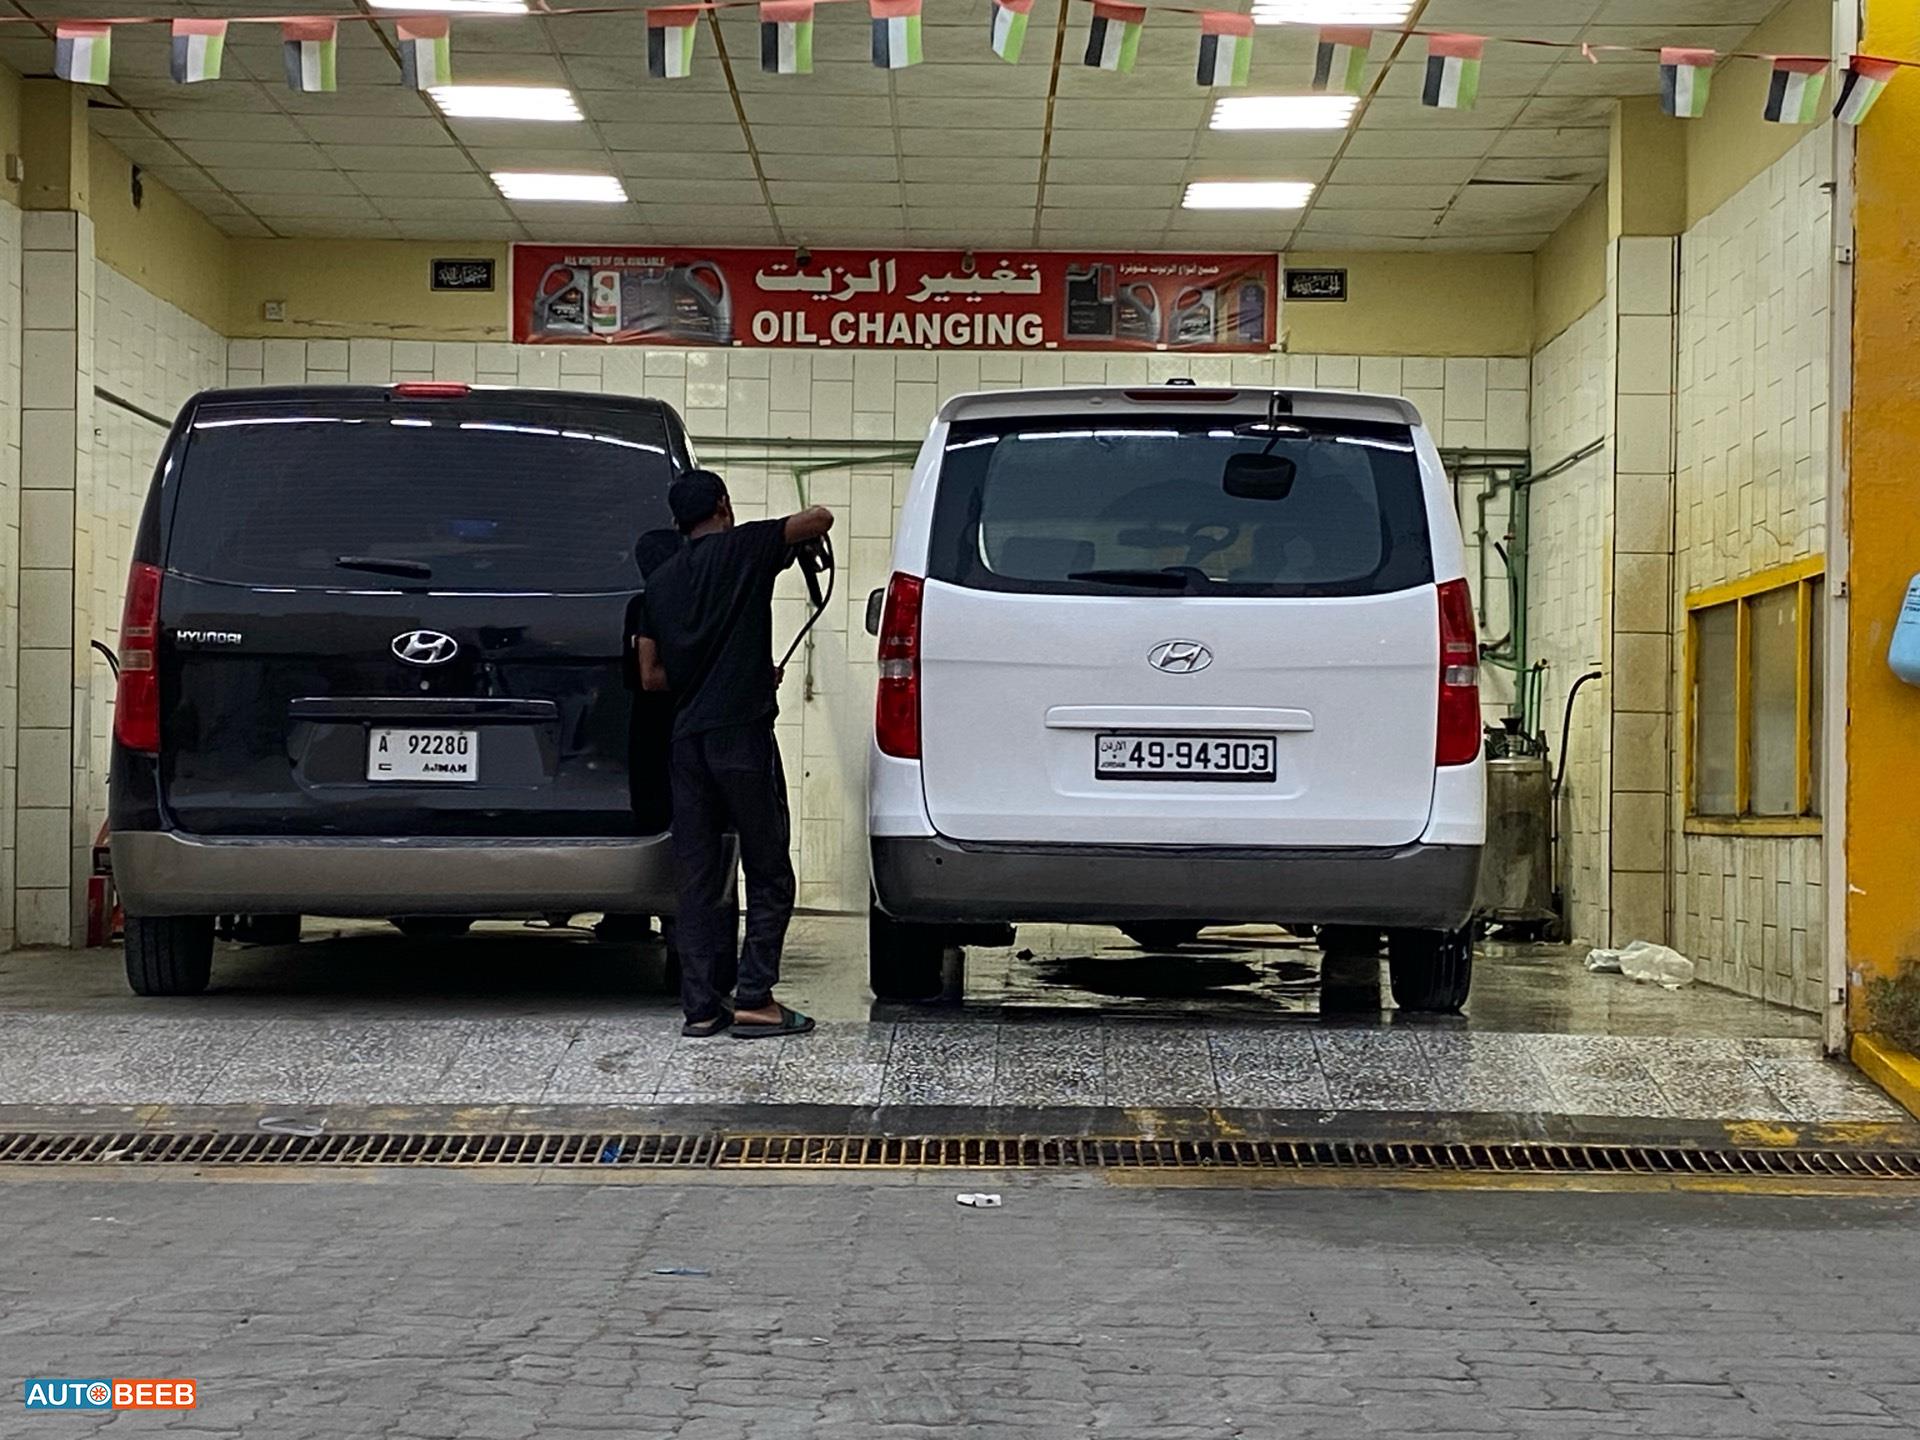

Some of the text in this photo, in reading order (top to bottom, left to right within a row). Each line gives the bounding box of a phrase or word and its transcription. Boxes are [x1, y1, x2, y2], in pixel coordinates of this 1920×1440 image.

[563, 256, 577, 266] ALL
[602, 256, 612, 266] OF
[755, 258, 1041, 302] تغيير الزيت
[752, 310, 1044, 345] OIL CHANGING
[176, 629, 242, 644] HYUNDAI
[379, 735, 468, 755] A 92280
[1129, 741, 1269, 770] 49-94303
